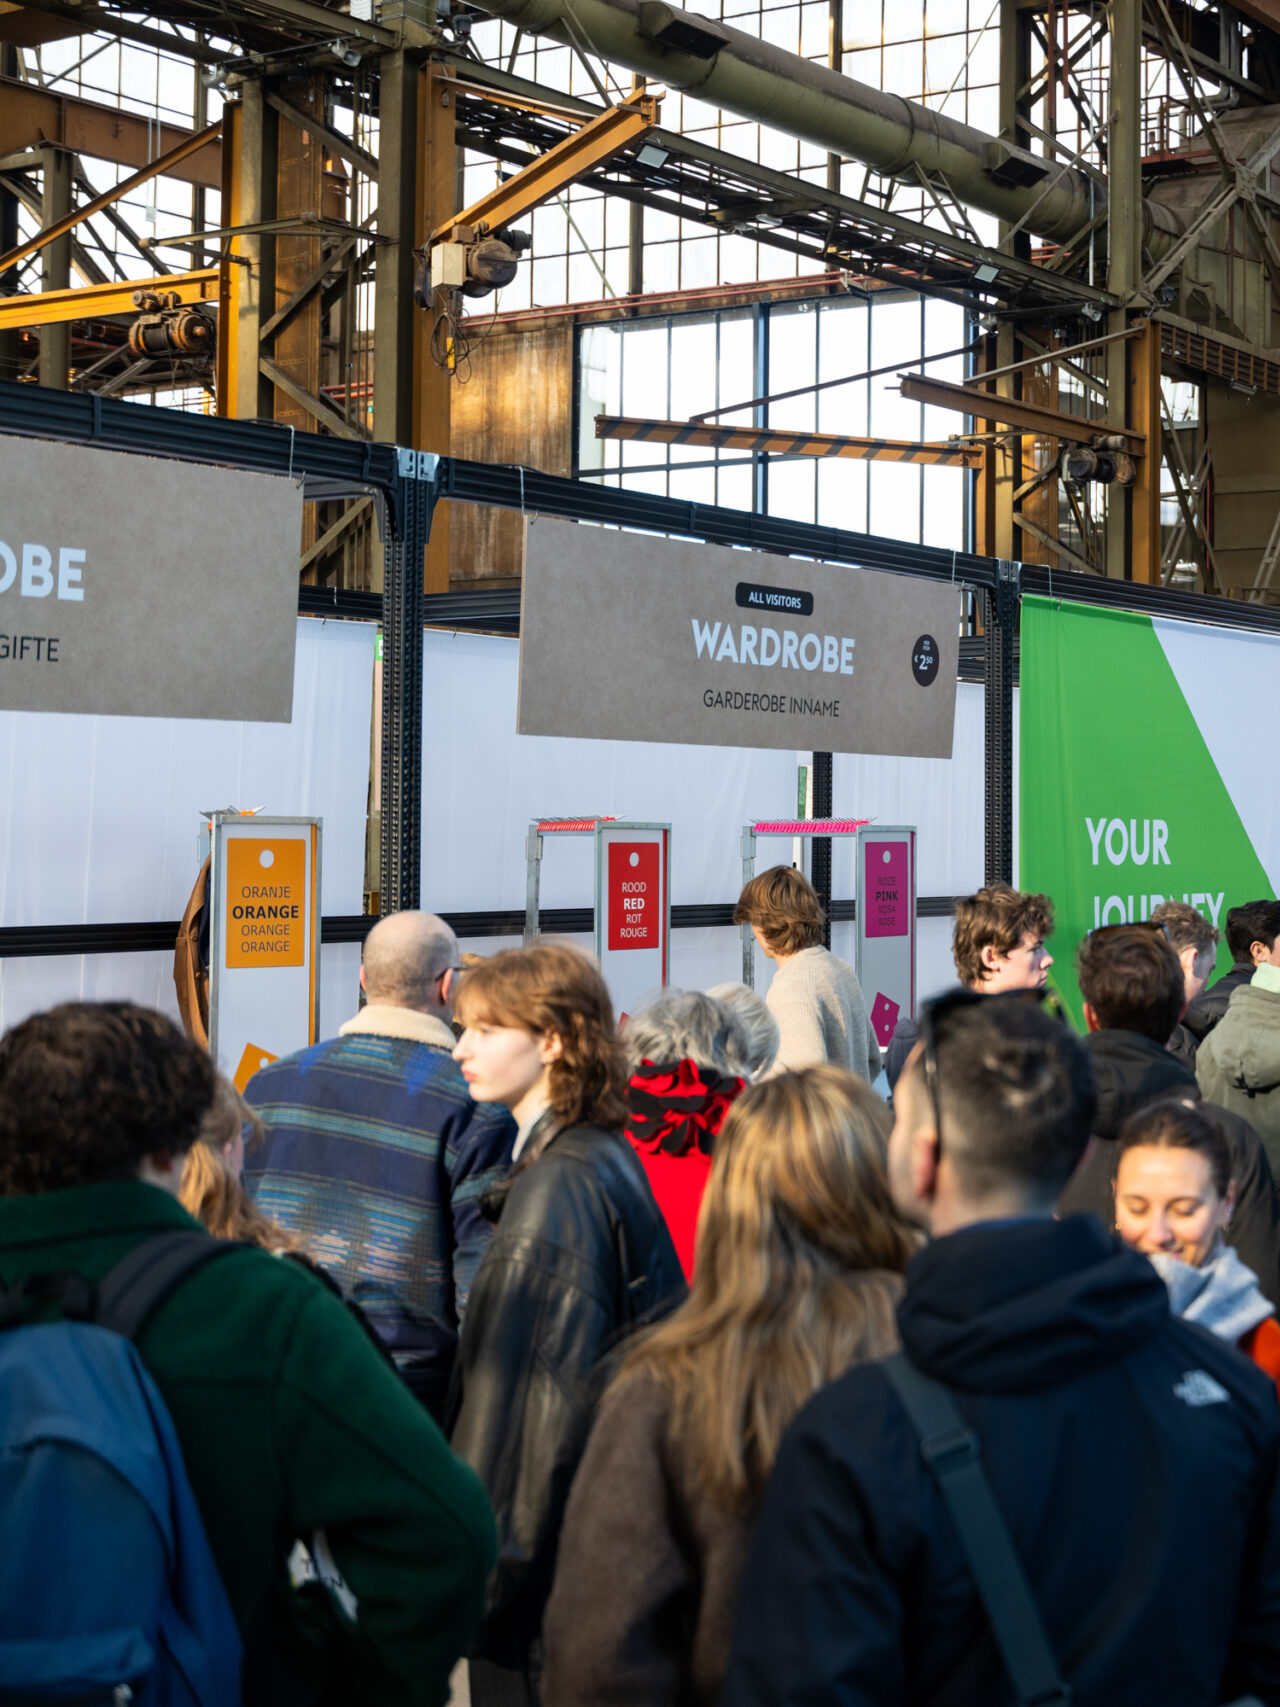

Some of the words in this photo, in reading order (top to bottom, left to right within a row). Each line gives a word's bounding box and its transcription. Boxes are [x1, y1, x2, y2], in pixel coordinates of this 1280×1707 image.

[748, 591, 764, 604] ALL
[766, 593, 802, 609] VISITORS
[691, 618, 855, 675] WARDROBE
[703, 689, 786, 713] GARDEROBE
[789, 697, 840, 717] INNAME
[1085, 817, 1171, 866] YOUR
[622, 882, 646, 892] ROOD
[877, 877, 896, 886] ROZE
[242, 886, 290, 898] ORANJE
[875, 891, 898, 901] PINK
[623, 898, 645, 910] RED
[878, 905, 896, 914] ROSA
[232, 905, 299, 919] ORANGE
[1087, 892, 1224, 932] JOUY
[626, 914, 642, 923] ROT
[241, 925, 290, 936] ORANGE
[620, 927, 647, 938] ROUGE
[241, 941, 290, 952] ORANGE
